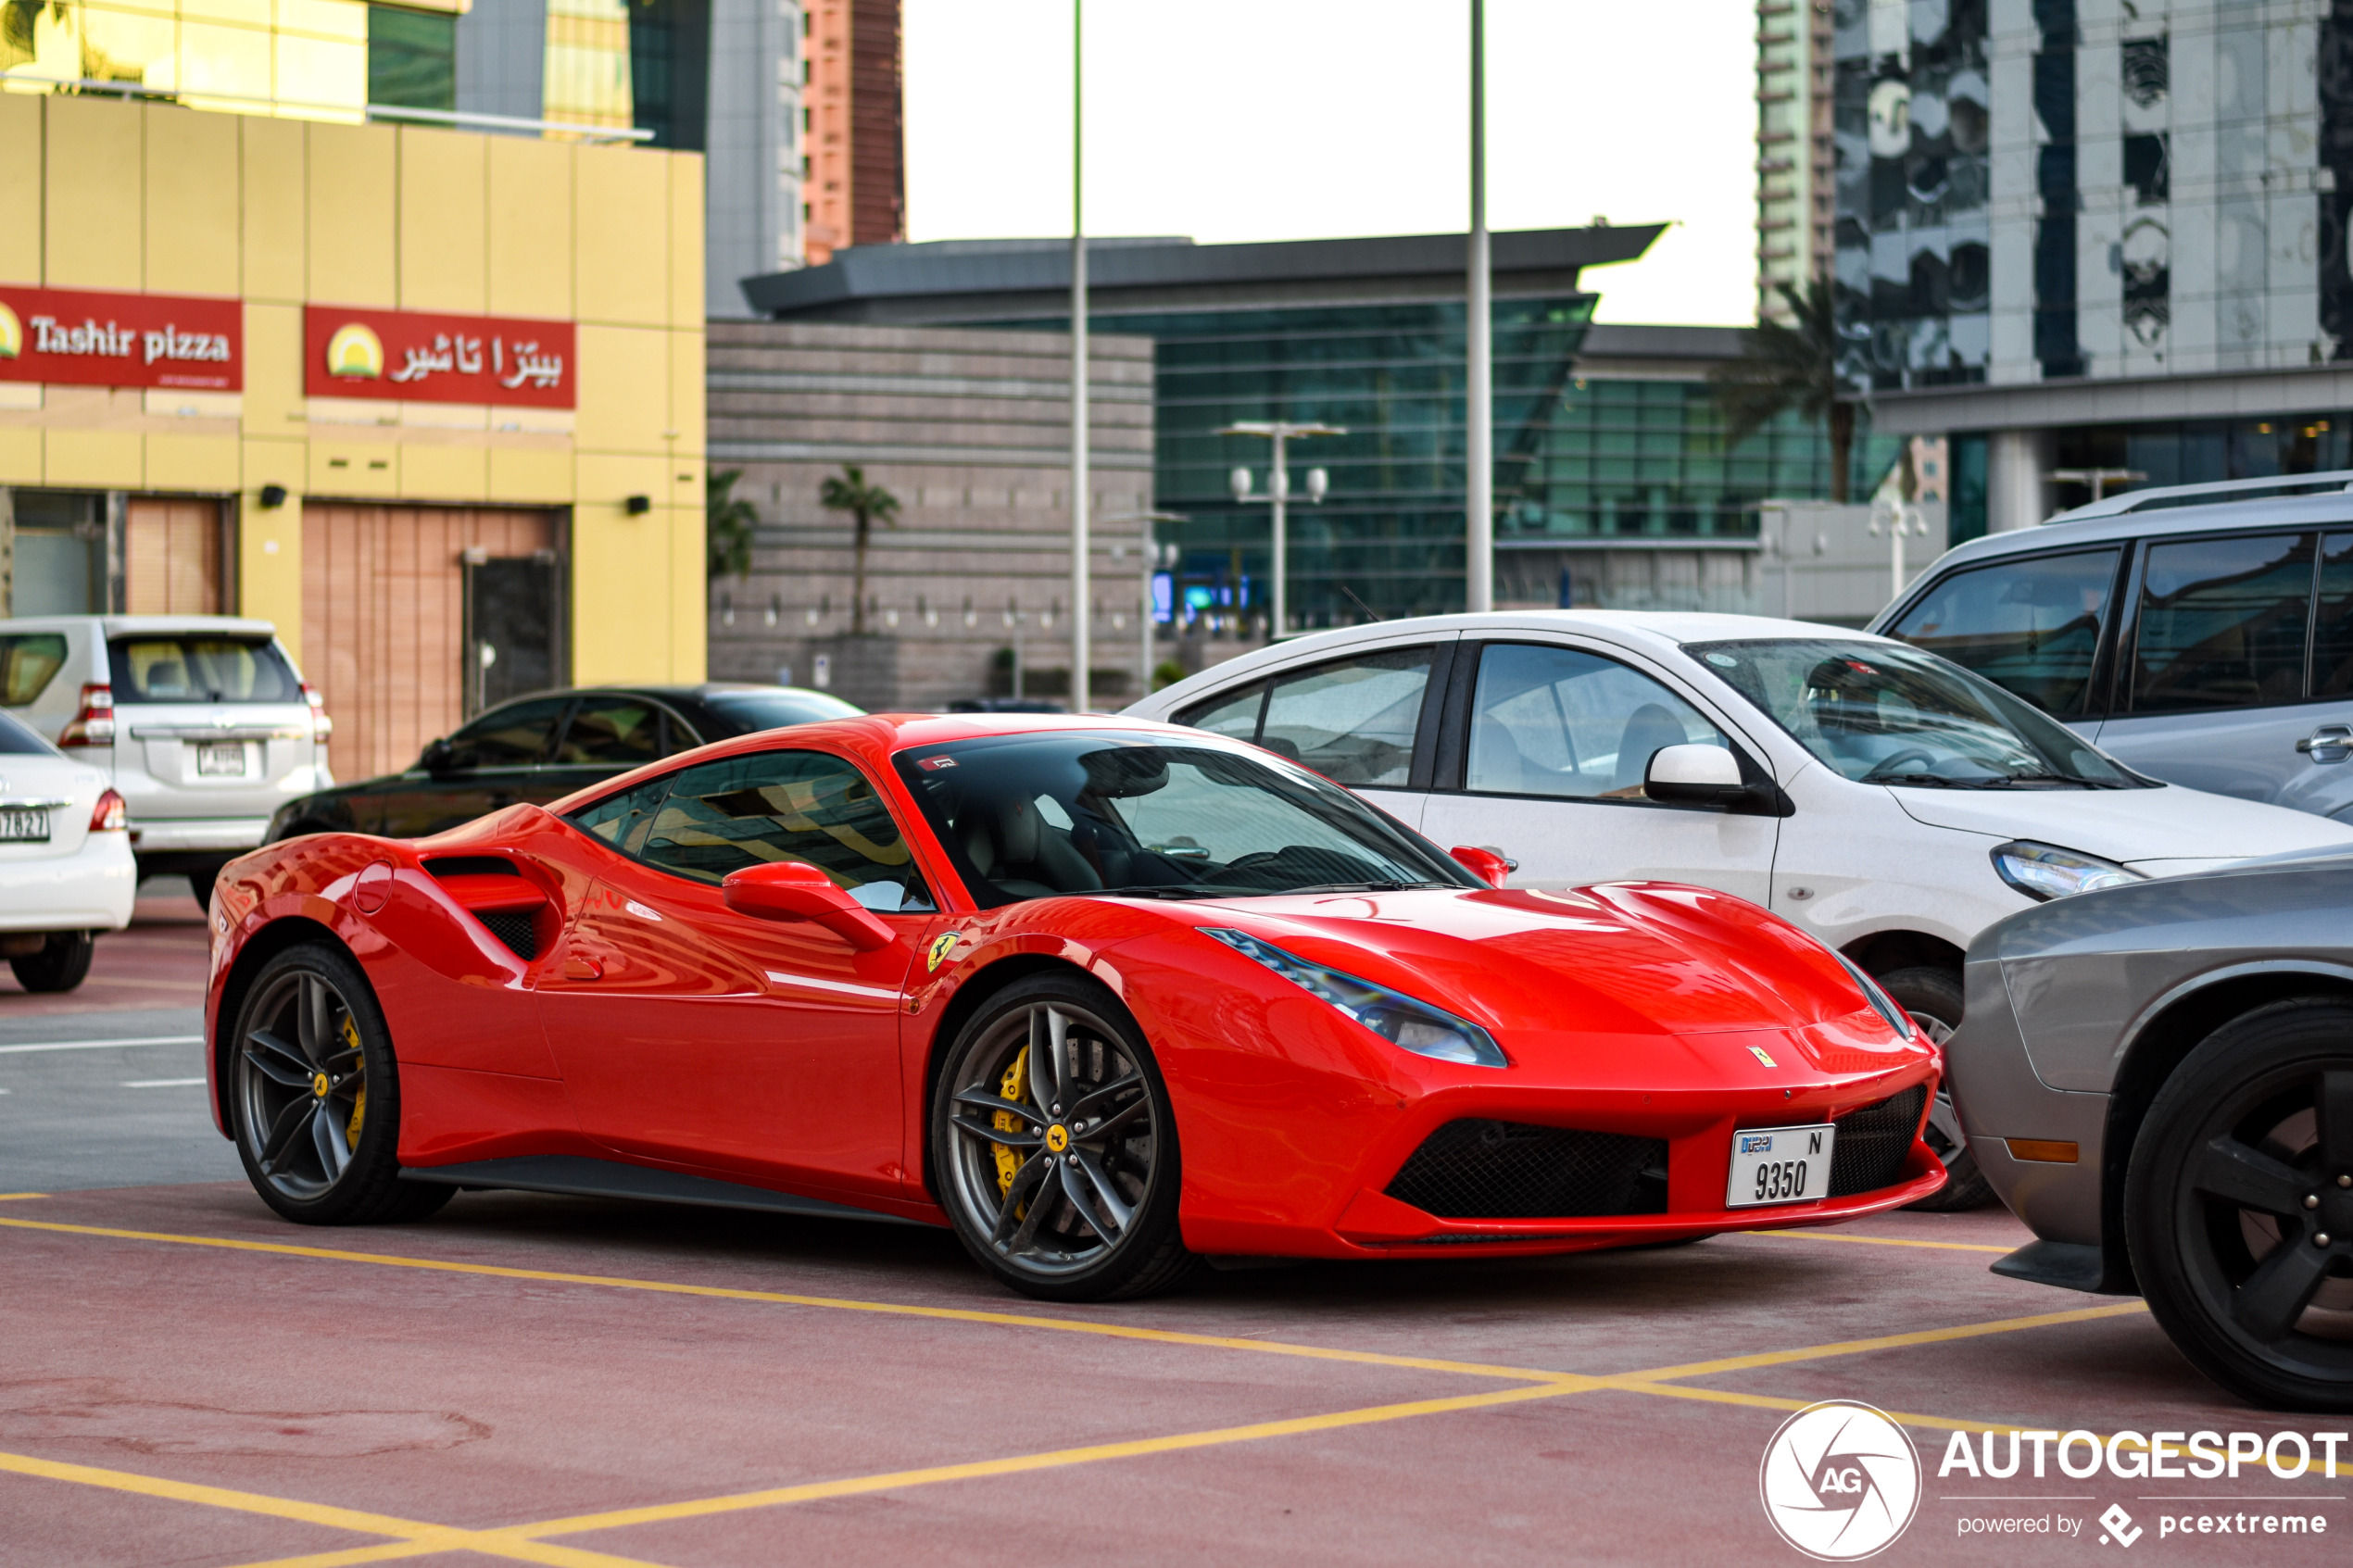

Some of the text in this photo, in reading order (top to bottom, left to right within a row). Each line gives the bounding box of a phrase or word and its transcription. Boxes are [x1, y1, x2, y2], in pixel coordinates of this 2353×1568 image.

[31, 316, 230, 365] Tashir pizza
[388, 332, 483, 383] تاشير
[0, 810, 44, 837] 7827
[1808, 1131, 1822, 1155] N
[1755, 1160, 1807, 1200] 9350
